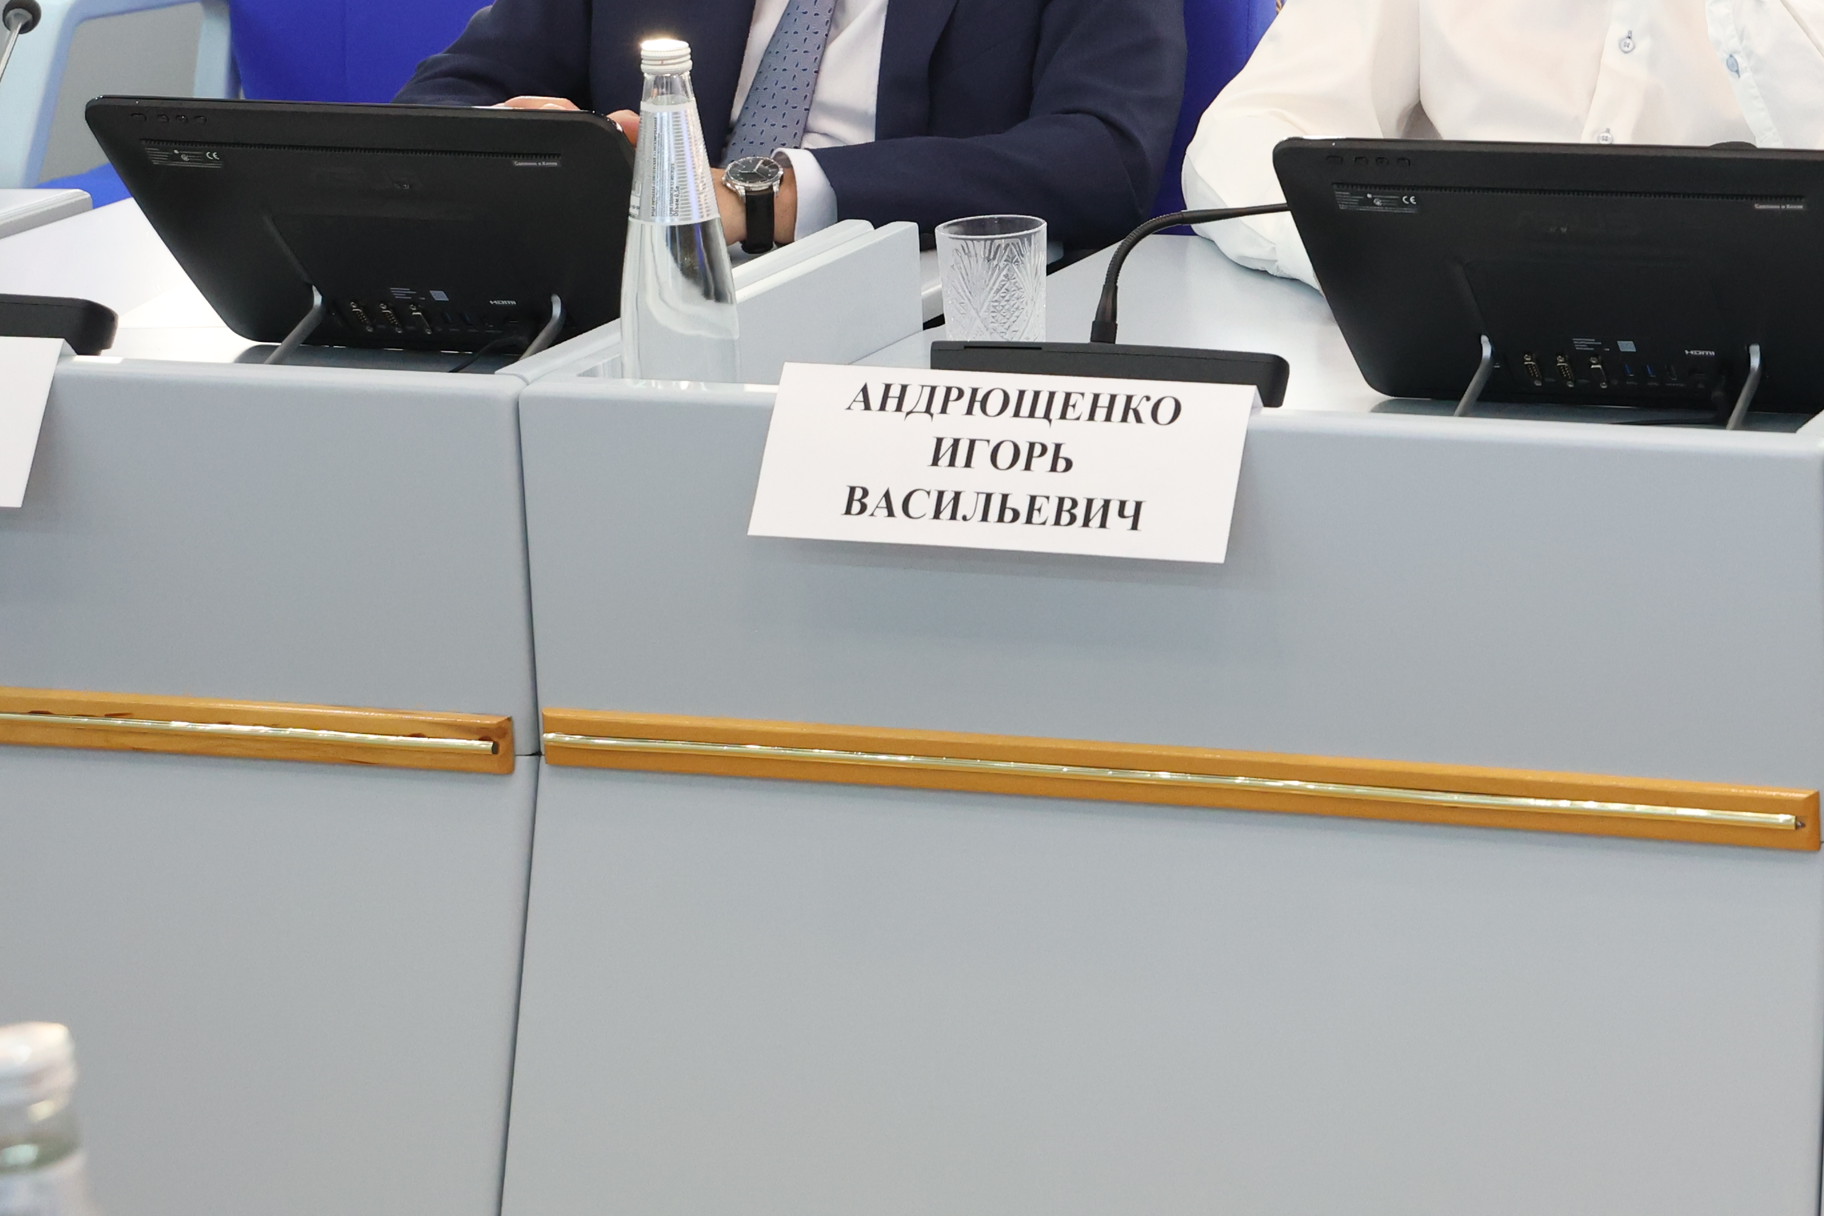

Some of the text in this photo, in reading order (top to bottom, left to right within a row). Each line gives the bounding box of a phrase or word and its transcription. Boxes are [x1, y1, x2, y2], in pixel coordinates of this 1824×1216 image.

[845, 382, 1182, 426] АНДРЮЩЕНКО
[928, 436, 1074, 474] ИГОРЬ
[842, 485, 1145, 531] ВАСИЛЬЕВИЧ
